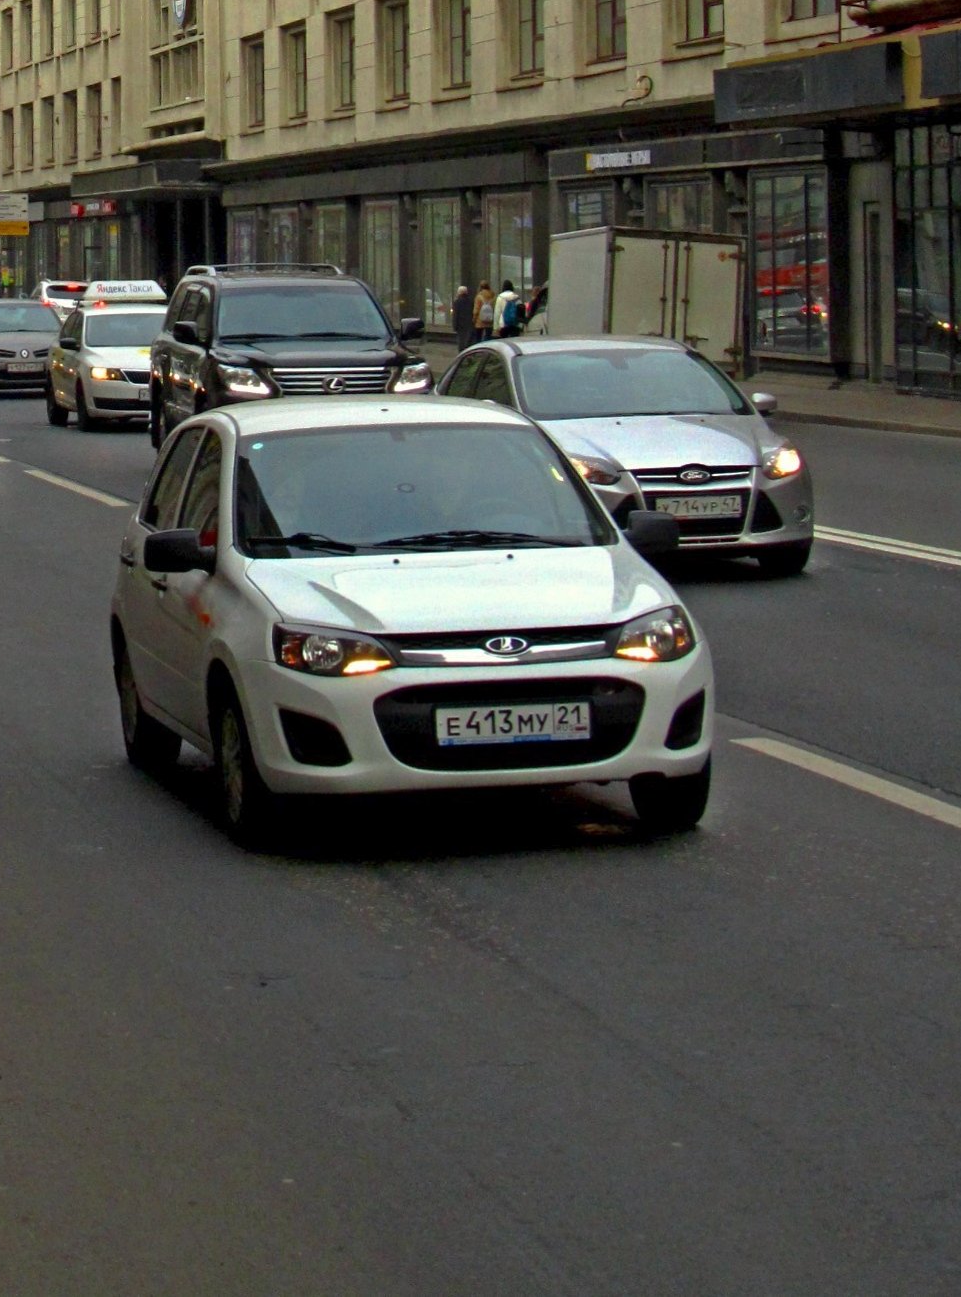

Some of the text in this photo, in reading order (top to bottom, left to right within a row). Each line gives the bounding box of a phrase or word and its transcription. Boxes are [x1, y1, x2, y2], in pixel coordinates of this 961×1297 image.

[97, 283, 153, 294] Яндекс Такси
[557, 705, 582, 724] 21
